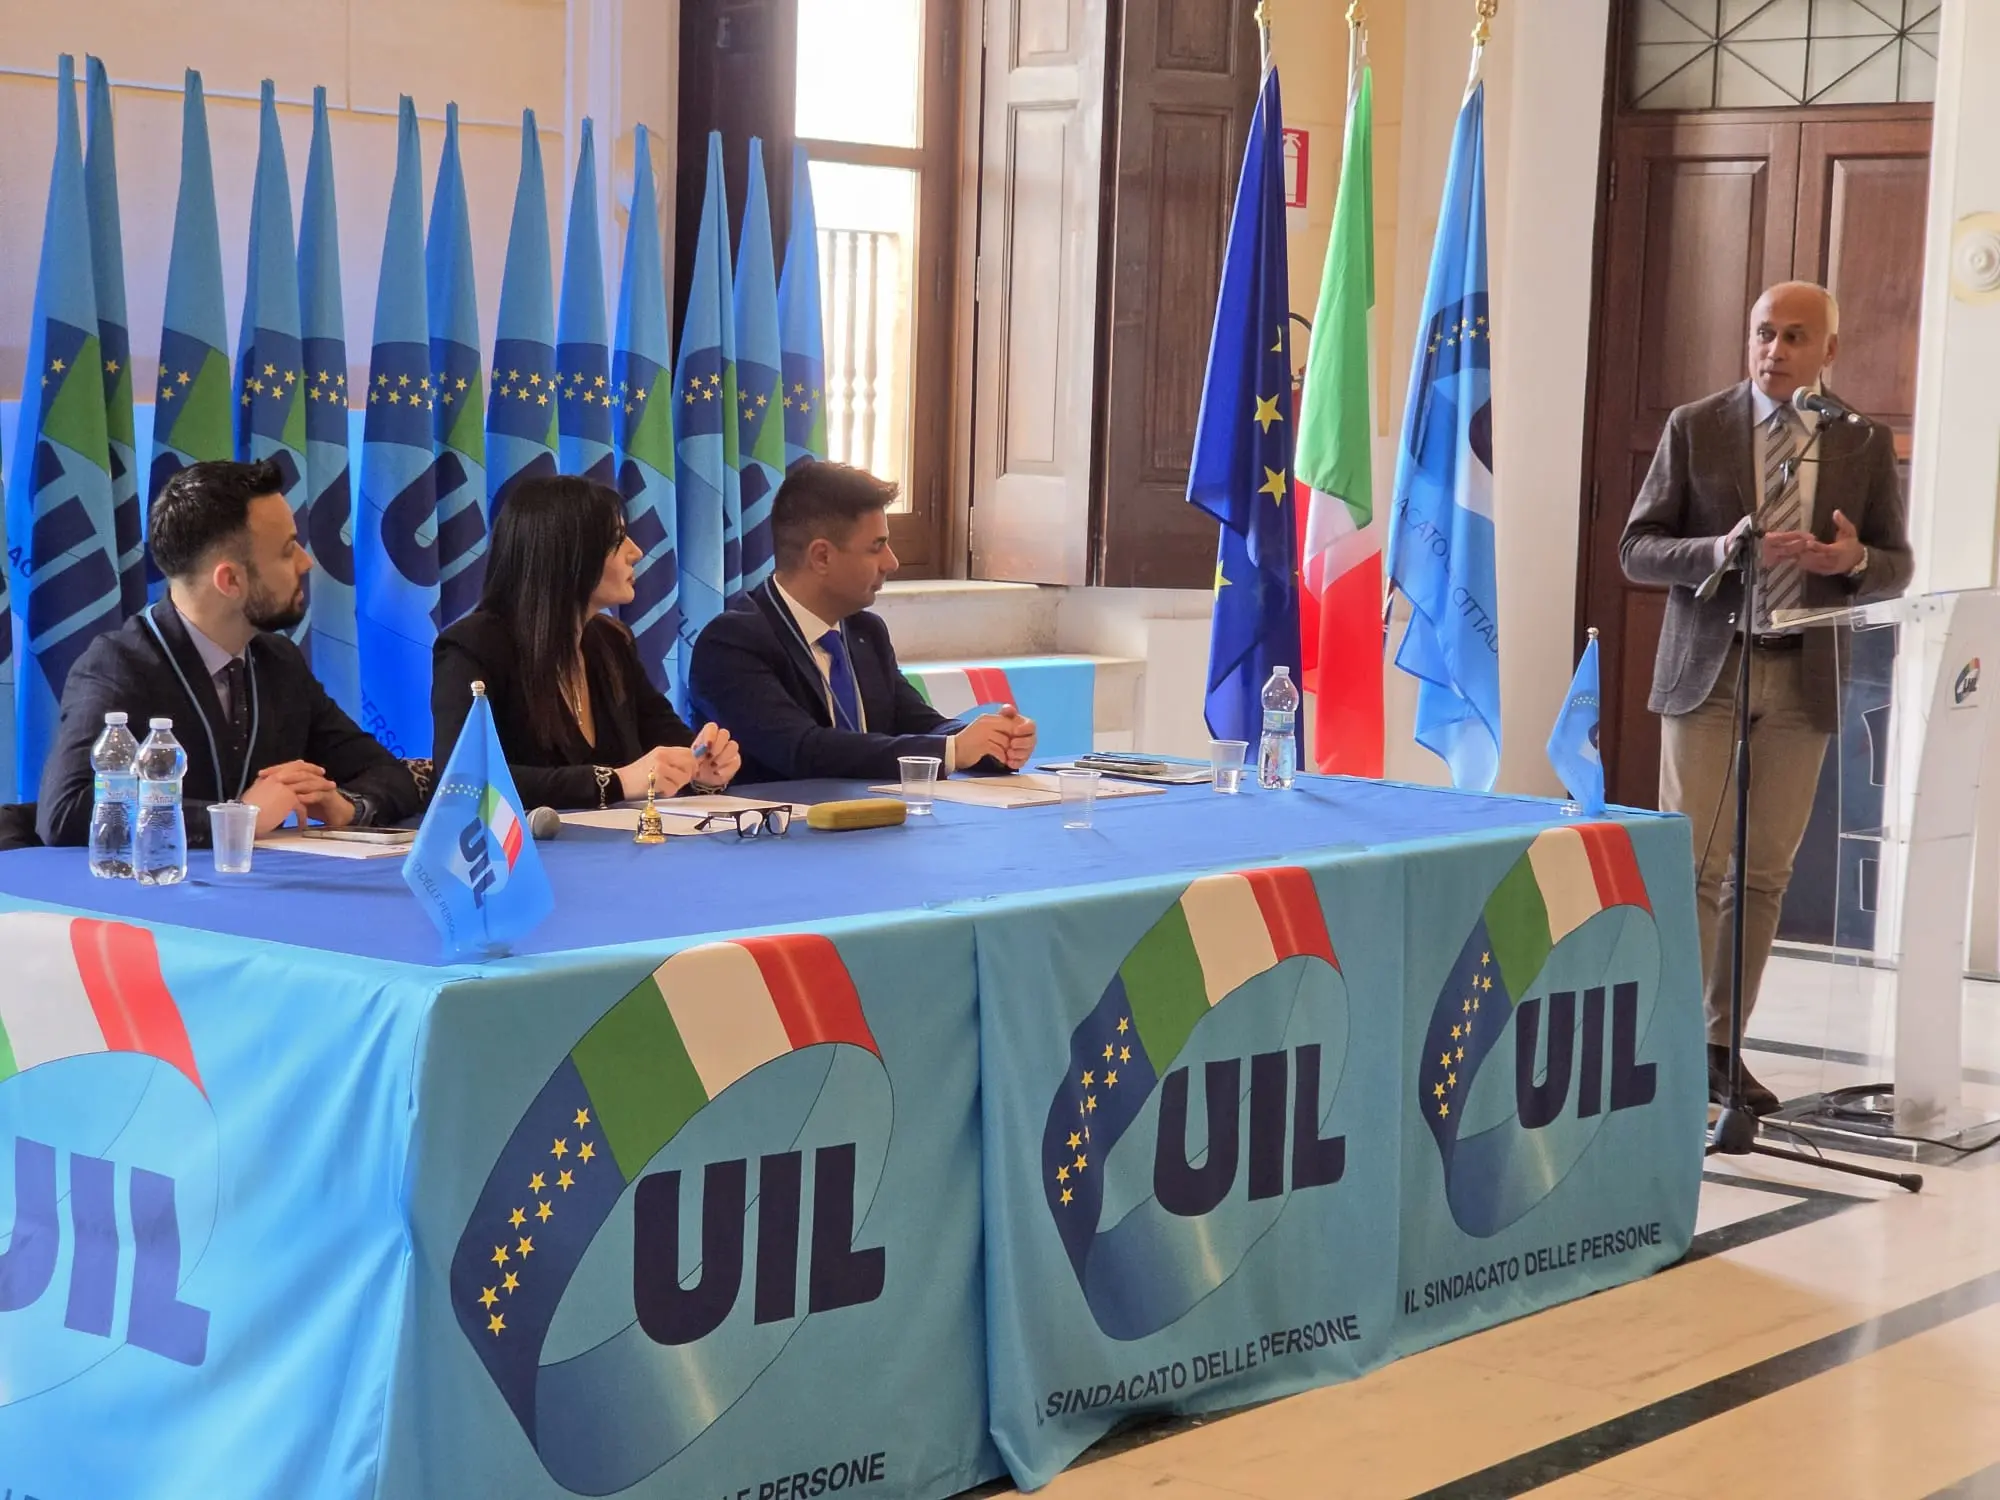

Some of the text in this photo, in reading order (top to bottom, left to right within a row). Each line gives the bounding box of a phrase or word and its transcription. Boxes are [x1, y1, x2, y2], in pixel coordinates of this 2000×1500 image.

[459, 815, 497, 910] UIL
[1515, 981, 1657, 1130] UIL
[1153, 1043, 1347, 1217] UIL
[633, 1142, 886, 1346] UIL
[1404, 1222, 1662, 1315] IL SINDACATO DELLE PERSONE
[1045, 1361, 1188, 1418] SINDACATO
[1192, 1341, 1258, 1384] DELLE
[1260, 1314, 1362, 1363] PERSONE
[758, 1451, 886, 1500] PERSONE
